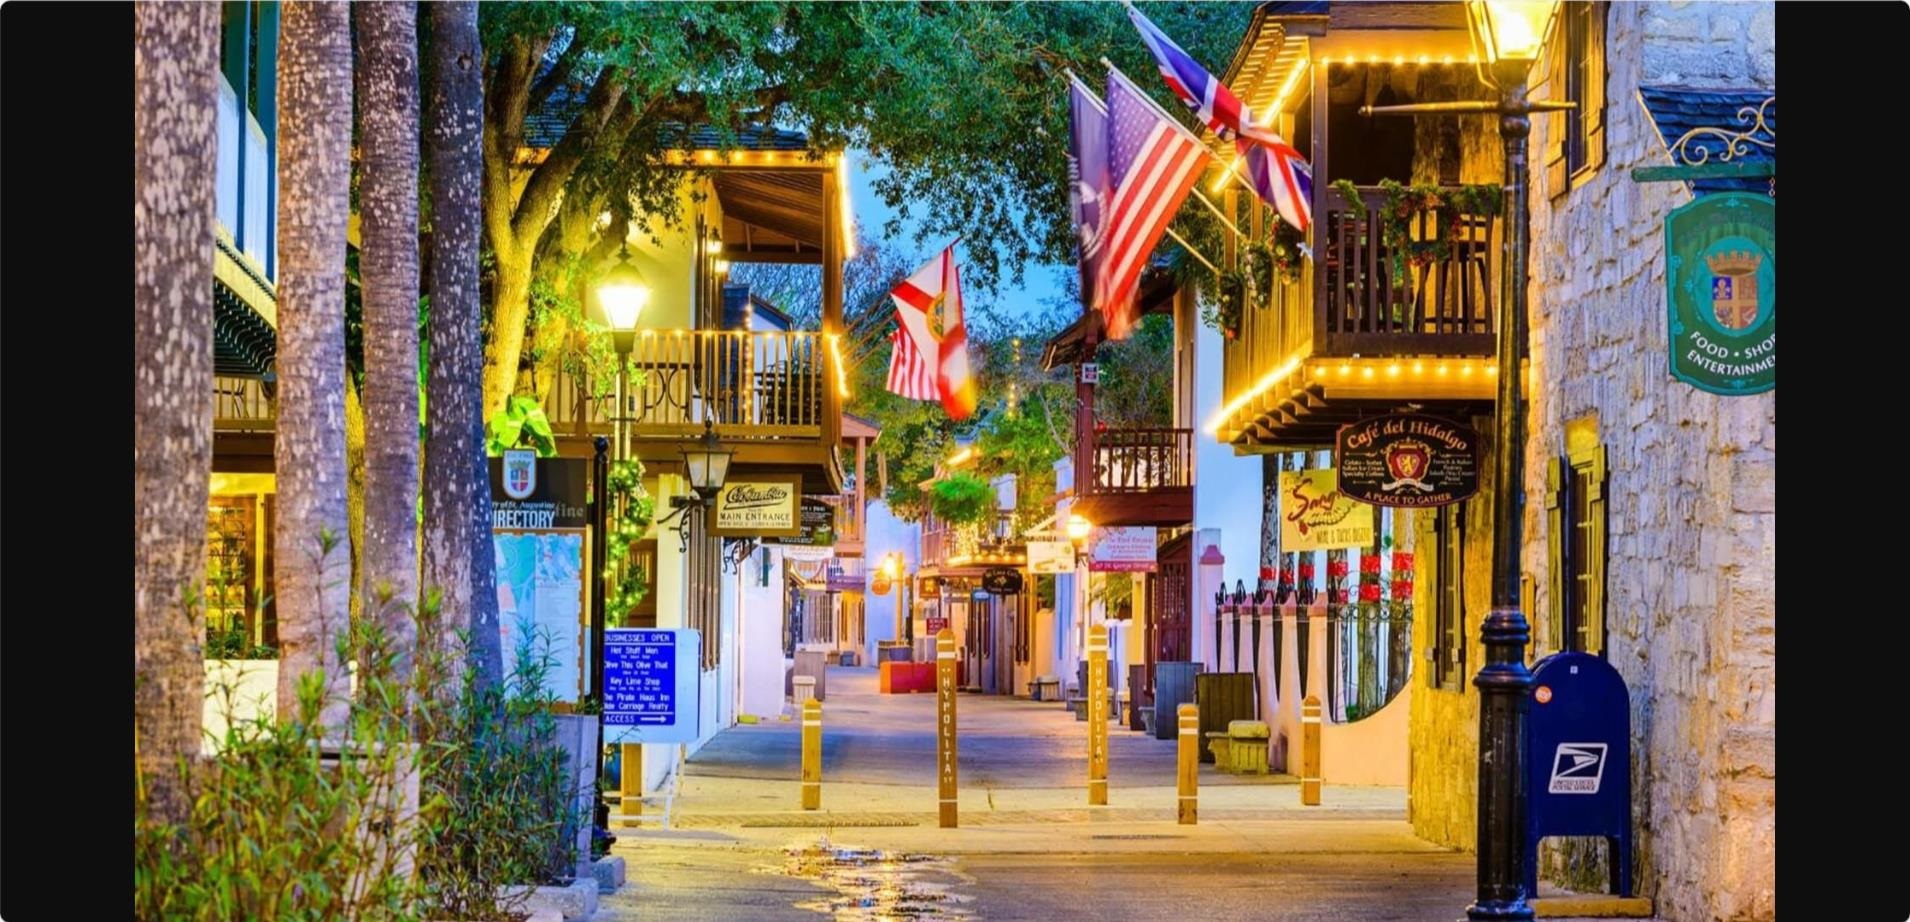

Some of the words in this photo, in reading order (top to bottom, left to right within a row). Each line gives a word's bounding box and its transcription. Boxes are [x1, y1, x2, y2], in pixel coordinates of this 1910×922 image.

[1690, 331, 1728, 358] FOOD
[1347, 421, 1380, 448] Café
[1383, 419, 1405, 435] del
[1409, 421, 1467, 450] Hidalgo
[1365, 491, 1371, 499] A
[1373, 493, 1398, 503] PLACE
[1402, 496, 1415, 504] TO
[1417, 493, 1452, 504] GATHER
[519, 501, 555, 510] Augustine
[492, 510, 555, 528] IRECTORY
[720, 513, 742, 521] MAIN
[745, 513, 790, 521] ENTRANCE
[604, 634, 645, 642] BUSINESSES
[651, 634, 670, 642] OPEN
[625, 646, 641, 654] Stuff
[621, 661, 633, 669] This
[636, 661, 651, 669] Olive
[654, 661, 668, 669] That
[610, 677, 622, 686] Key
[625, 677, 641, 685] Lime
[645, 677, 661, 686] Shop
[617, 693, 635, 701] Pirate
[639, 693, 655, 701] Haus
[660, 693, 670, 701] Inn
[618, 702, 645, 711] Carriage
[648, 702, 669, 711] Realty
[1095, 666, 1103, 754] HYPOLITA
[605, 715, 634, 723] ACCESS
[943, 677, 952, 774] HYPOLITA
